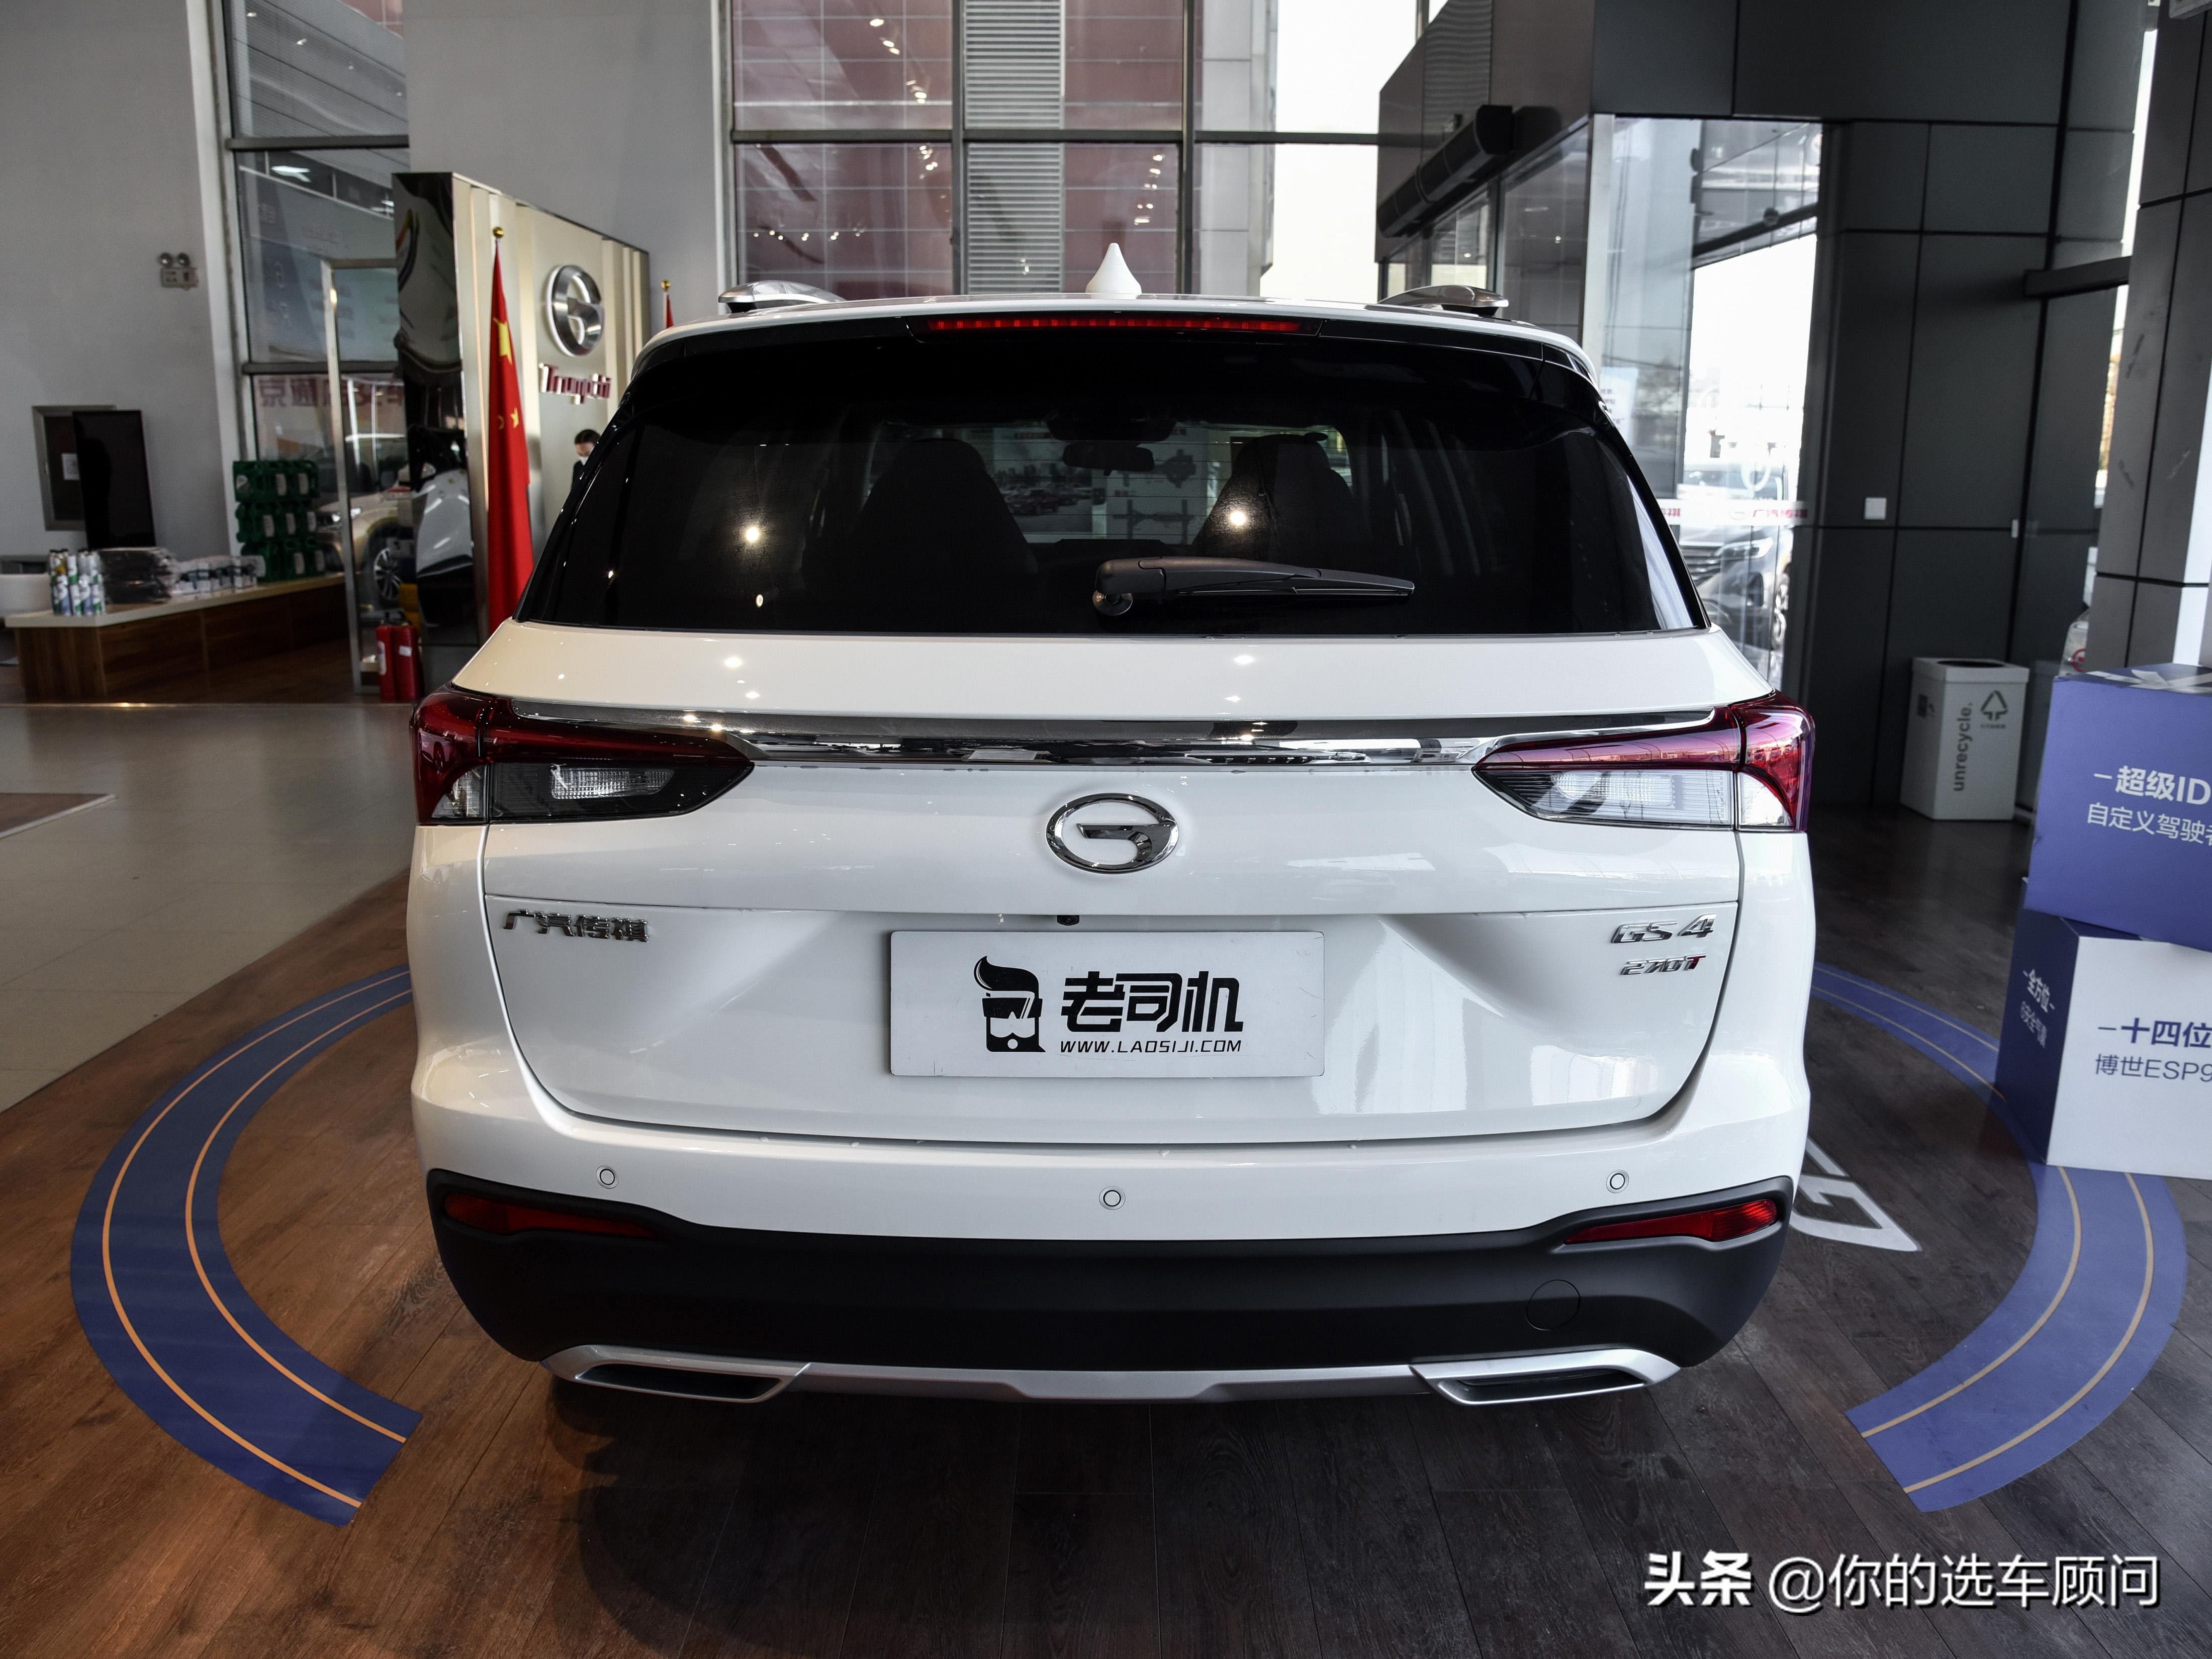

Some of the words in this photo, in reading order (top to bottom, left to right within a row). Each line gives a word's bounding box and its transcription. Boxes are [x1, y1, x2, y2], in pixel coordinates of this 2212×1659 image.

[503, 909, 650, 943] 广汽传祺
[1619, 954, 1708, 976] 270T
[1059, 970, 1244, 1033] 老司机
[1060, 1040, 1242, 1053] WWW.LAOSIJI.COM
